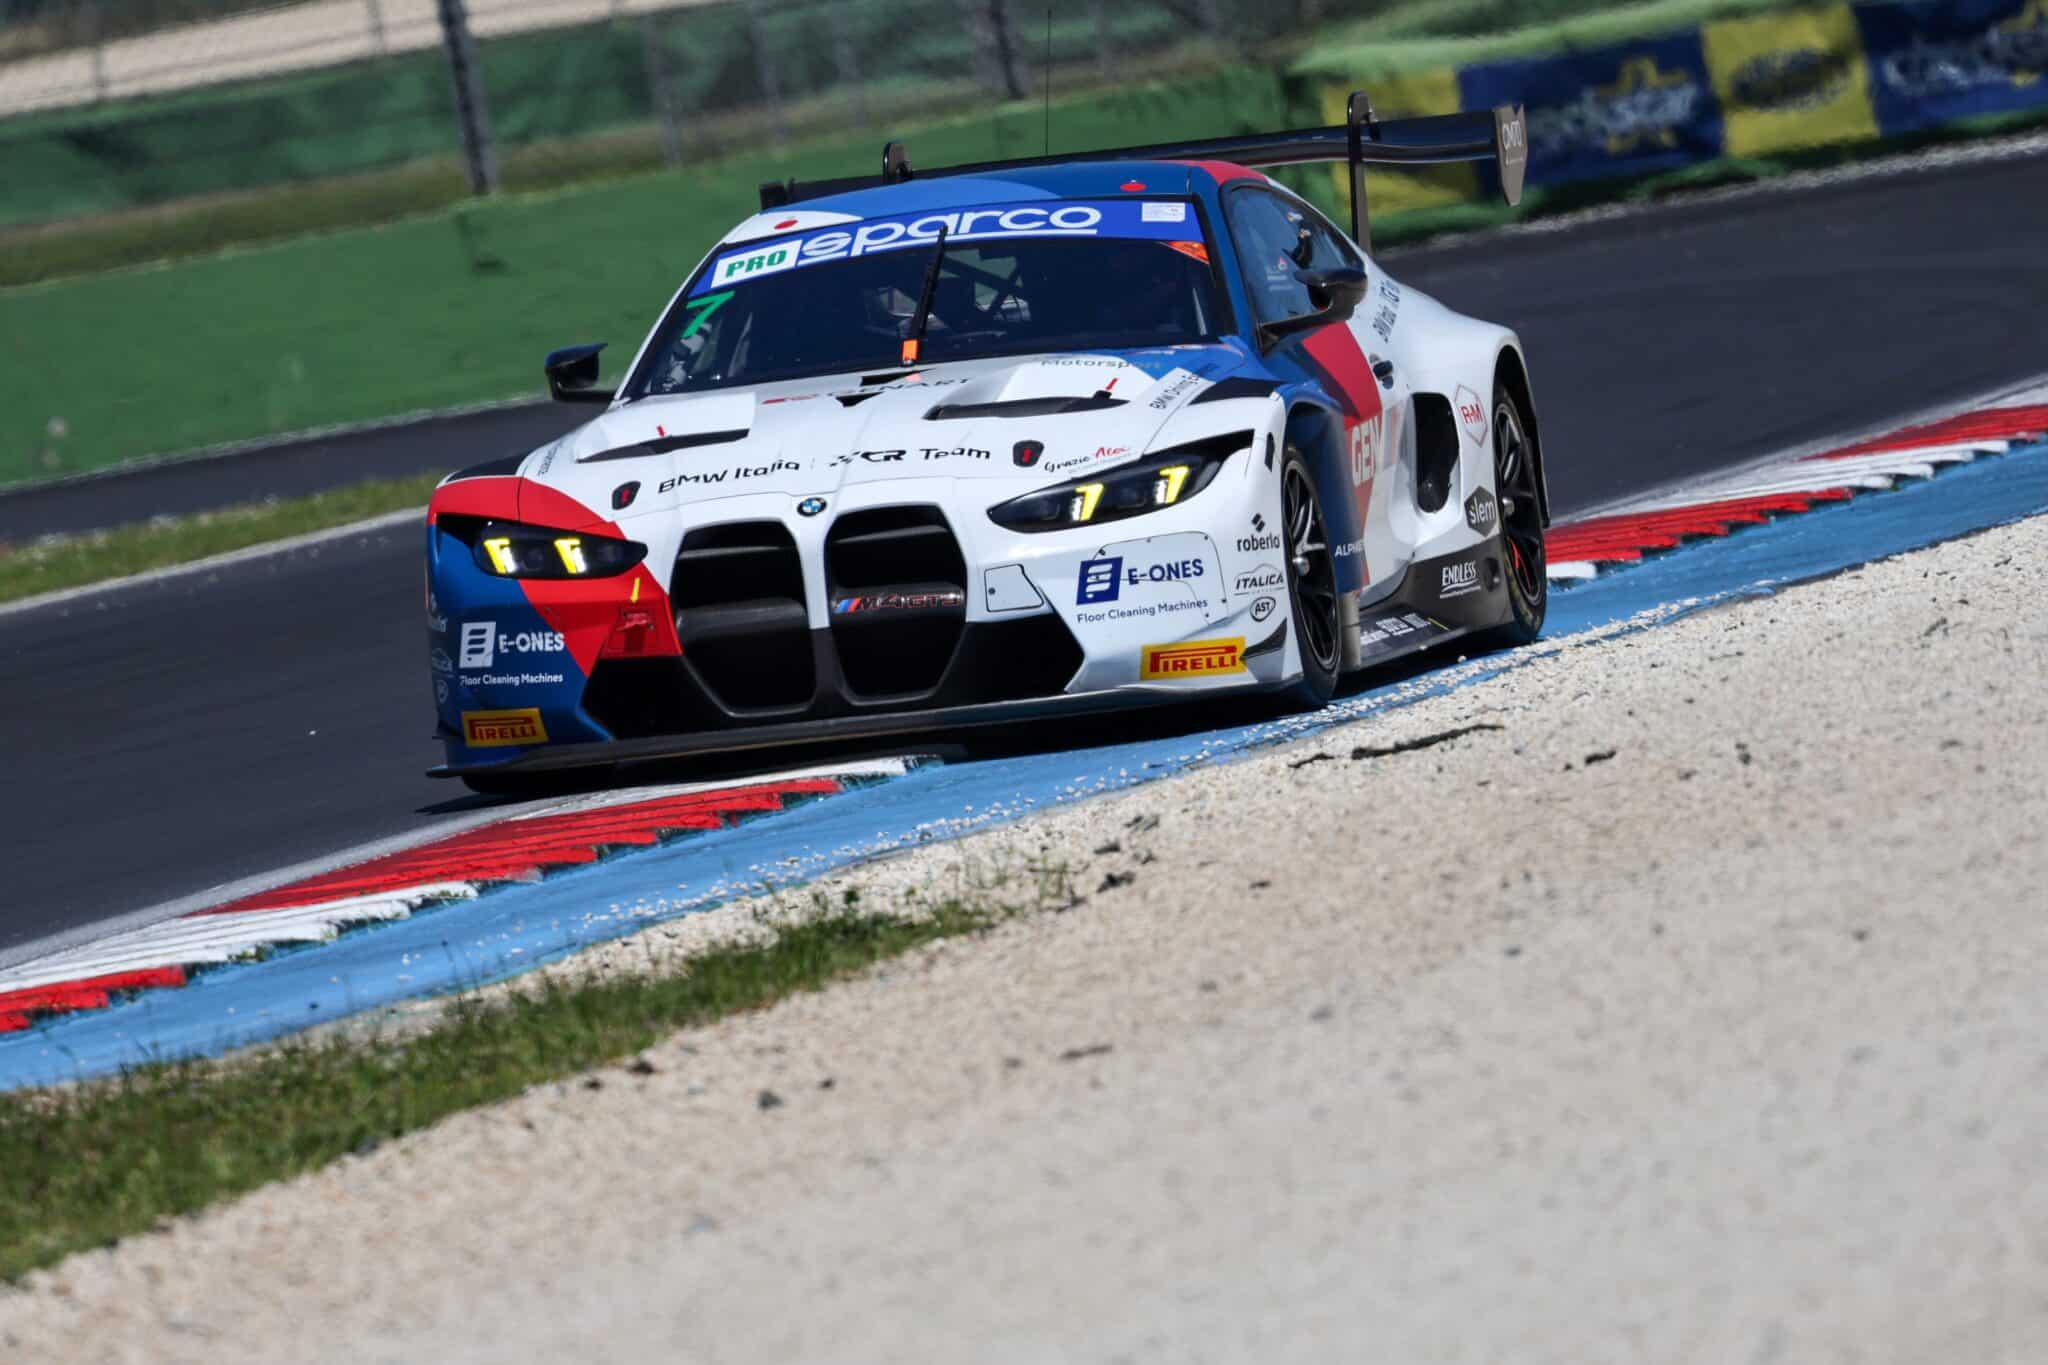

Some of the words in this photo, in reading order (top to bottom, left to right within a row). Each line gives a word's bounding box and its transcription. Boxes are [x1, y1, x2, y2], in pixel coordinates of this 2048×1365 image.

[801, 206, 1101, 258] sparco
[726, 250, 787, 278] PRO
[682, 290, 735, 338] 7
[919, 447, 991, 461] Team
[658, 469, 728, 494] BMW
[734, 459, 801, 479] Italia
[1128, 559, 1204, 585] E-ONES
[1236, 573, 1284, 590] ITALICA
[1442, 560, 1477, 587] ENDLESS
[1077, 613, 1105, 623] Floor
[1108, 608, 1156, 620] Cleaning
[1158, 600, 1208, 612] Machines
[1254, 602, 1272, 616] AST
[499, 632, 565, 653] E-ONES
[1150, 646, 1237, 673] PIRELLI
[482, 673, 519, 686] Cleaning
[521, 672, 564, 684] Machines
[467, 717, 537, 740] PIRELLI
